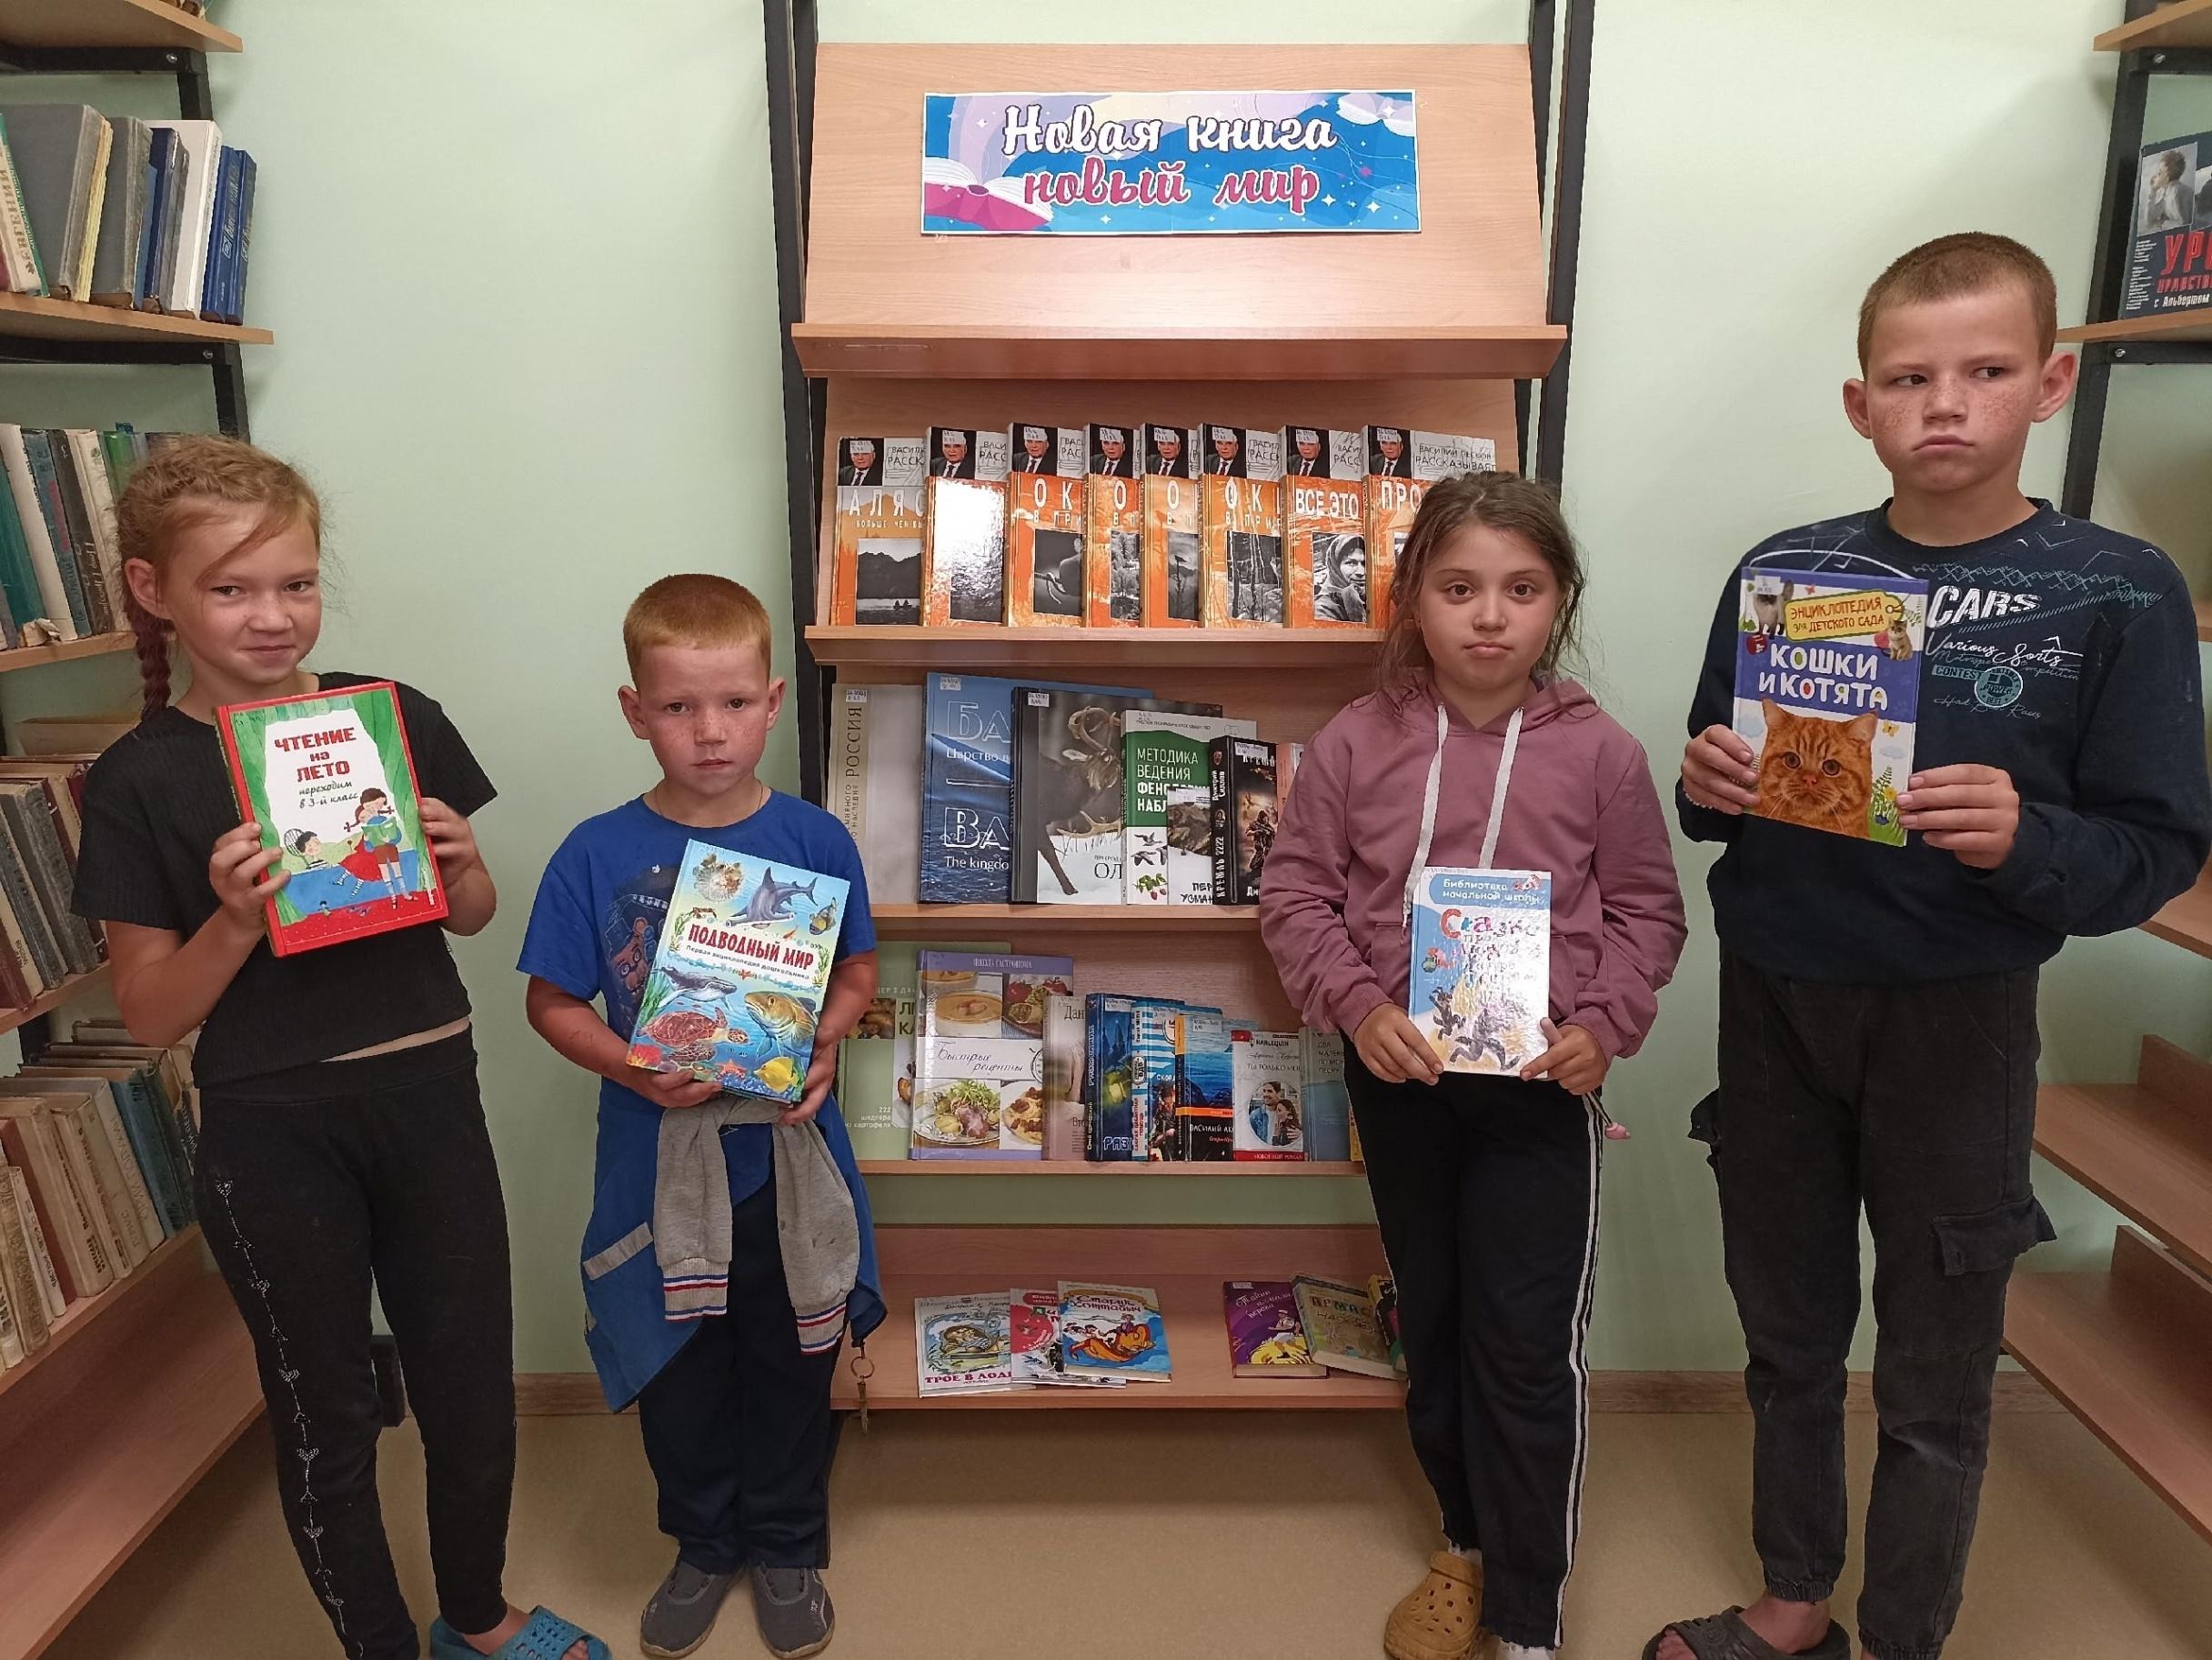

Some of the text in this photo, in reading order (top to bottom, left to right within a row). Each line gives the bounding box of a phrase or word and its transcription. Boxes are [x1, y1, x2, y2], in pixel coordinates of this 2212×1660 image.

[1001, 104, 1337, 156] Новая книга
[1022, 156, 1321, 215] новый мир
[888, 456, 925, 467] РАССК
[1295, 487, 1360, 519] ВСЕ ЭТО
[1790, 597, 1883, 620] ЭНЦИКЛОПЕДИЯ
[1926, 584, 2044, 629] CARS
[1808, 618, 1855, 634] ДЕТСКОГО
[1858, 614, 1885, 628] САДА
[1925, 630, 2000, 658] Various
[1770, 643, 1879, 681] КОШКИ
[1936, 666, 1982, 682] CONTEST
[1758, 671, 1888, 711] И КОТЯТА
[274, 727, 357, 753] ЧТЕНИЕ
[846, 707, 862, 778] РОССИЯ
[309, 750, 330, 762] на
[946, 748, 999, 763] Царство
[1137, 748, 1199, 765] МЕТОДИКА
[297, 760, 351, 782] ЛЕТО
[1137, 764, 1191, 781] ВЕДЕНИЯ
[298, 780, 353, 798] переходим
[299, 792, 359, 810] в 3-й класс
[944, 855, 1010, 872] The kingdo
[1215, 836, 1226, 898] КРЕМЛЬ 2222
[1443, 878, 1508, 890] Библиотека
[1443, 890, 1542, 903] начальной школы
[688, 923, 814, 971] ПОДВОДНЫЙ МИР
[686, 944, 810, 981] Первая энциклопедия дошкольника
[933, 1040, 992, 1065] Быстрые
[1255, 1039, 1289, 1048] HARLEQUIN
[972, 1062, 1023, 1075] рецепты
[1103, 1136, 1131, 1152] РАЗ
